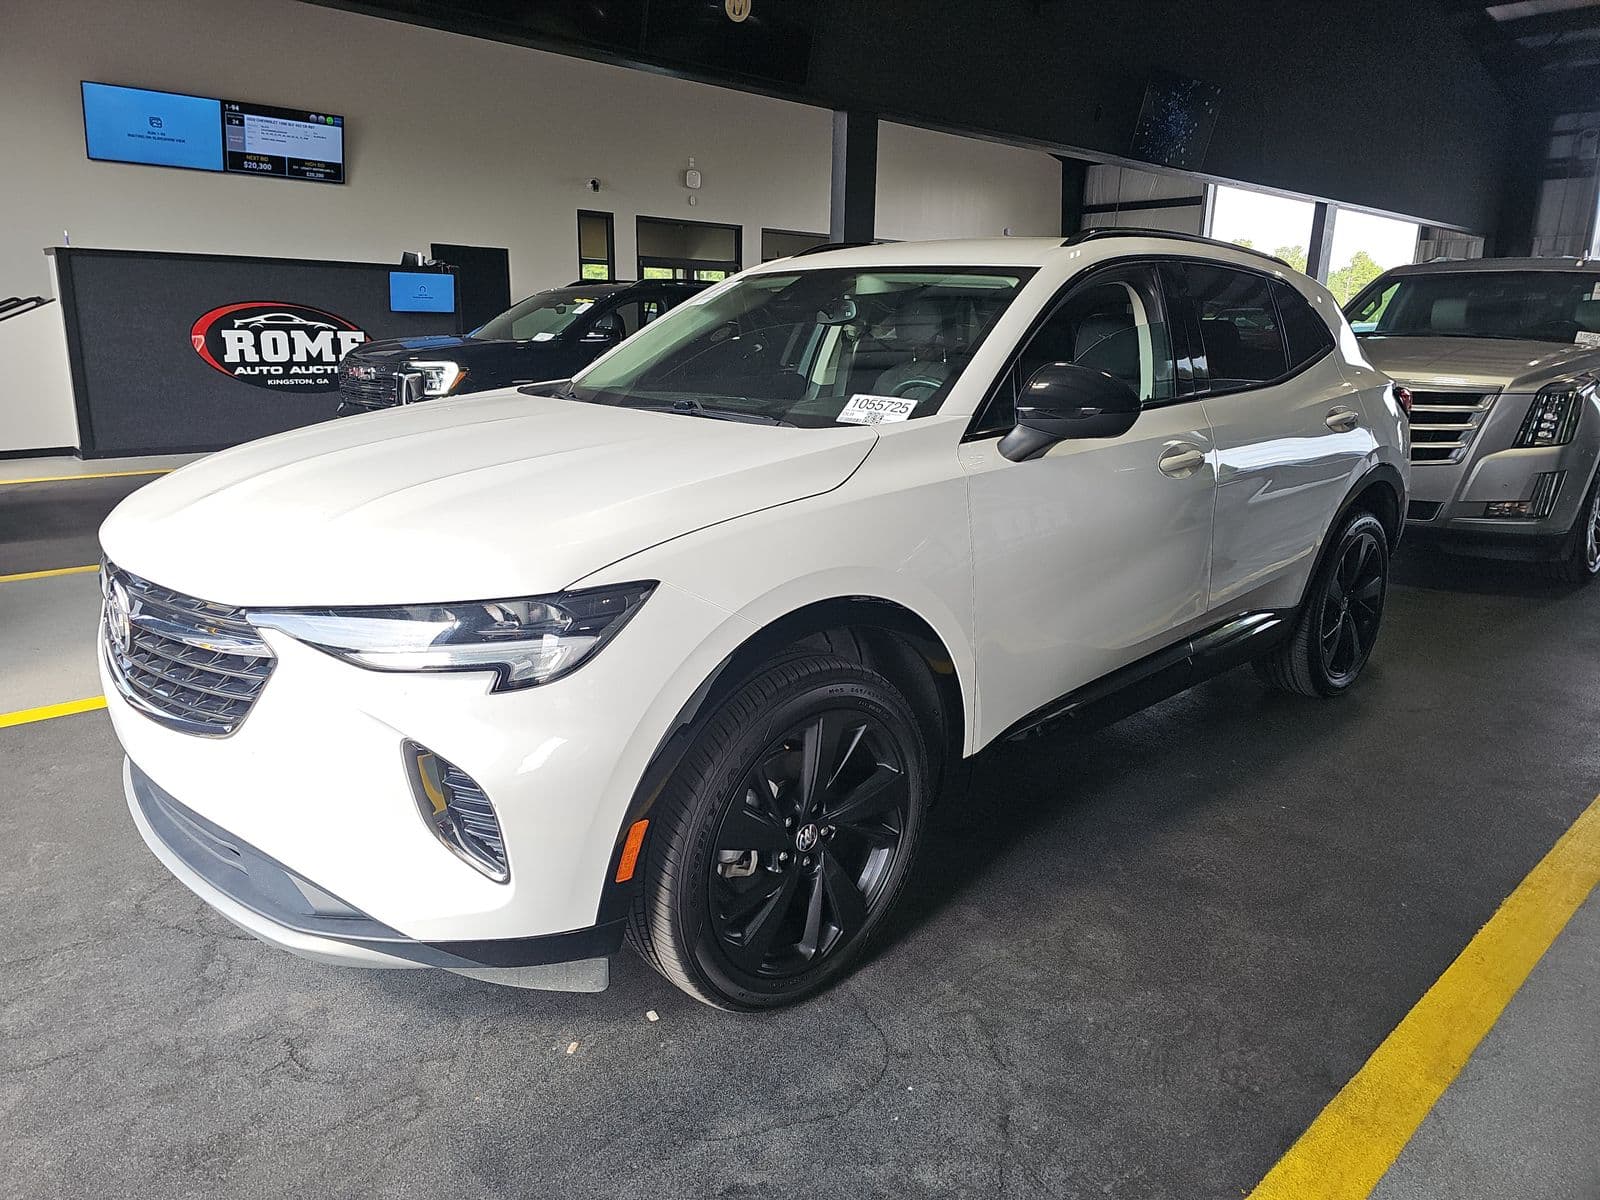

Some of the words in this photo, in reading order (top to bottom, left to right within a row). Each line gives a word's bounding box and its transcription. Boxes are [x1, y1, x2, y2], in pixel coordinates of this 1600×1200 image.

[234, 366, 284, 375] AUTO
[289, 365, 338, 375] AUCTI
[267, 378, 315, 386] KINGSTON,
[852, 398, 912, 414] 1055725
